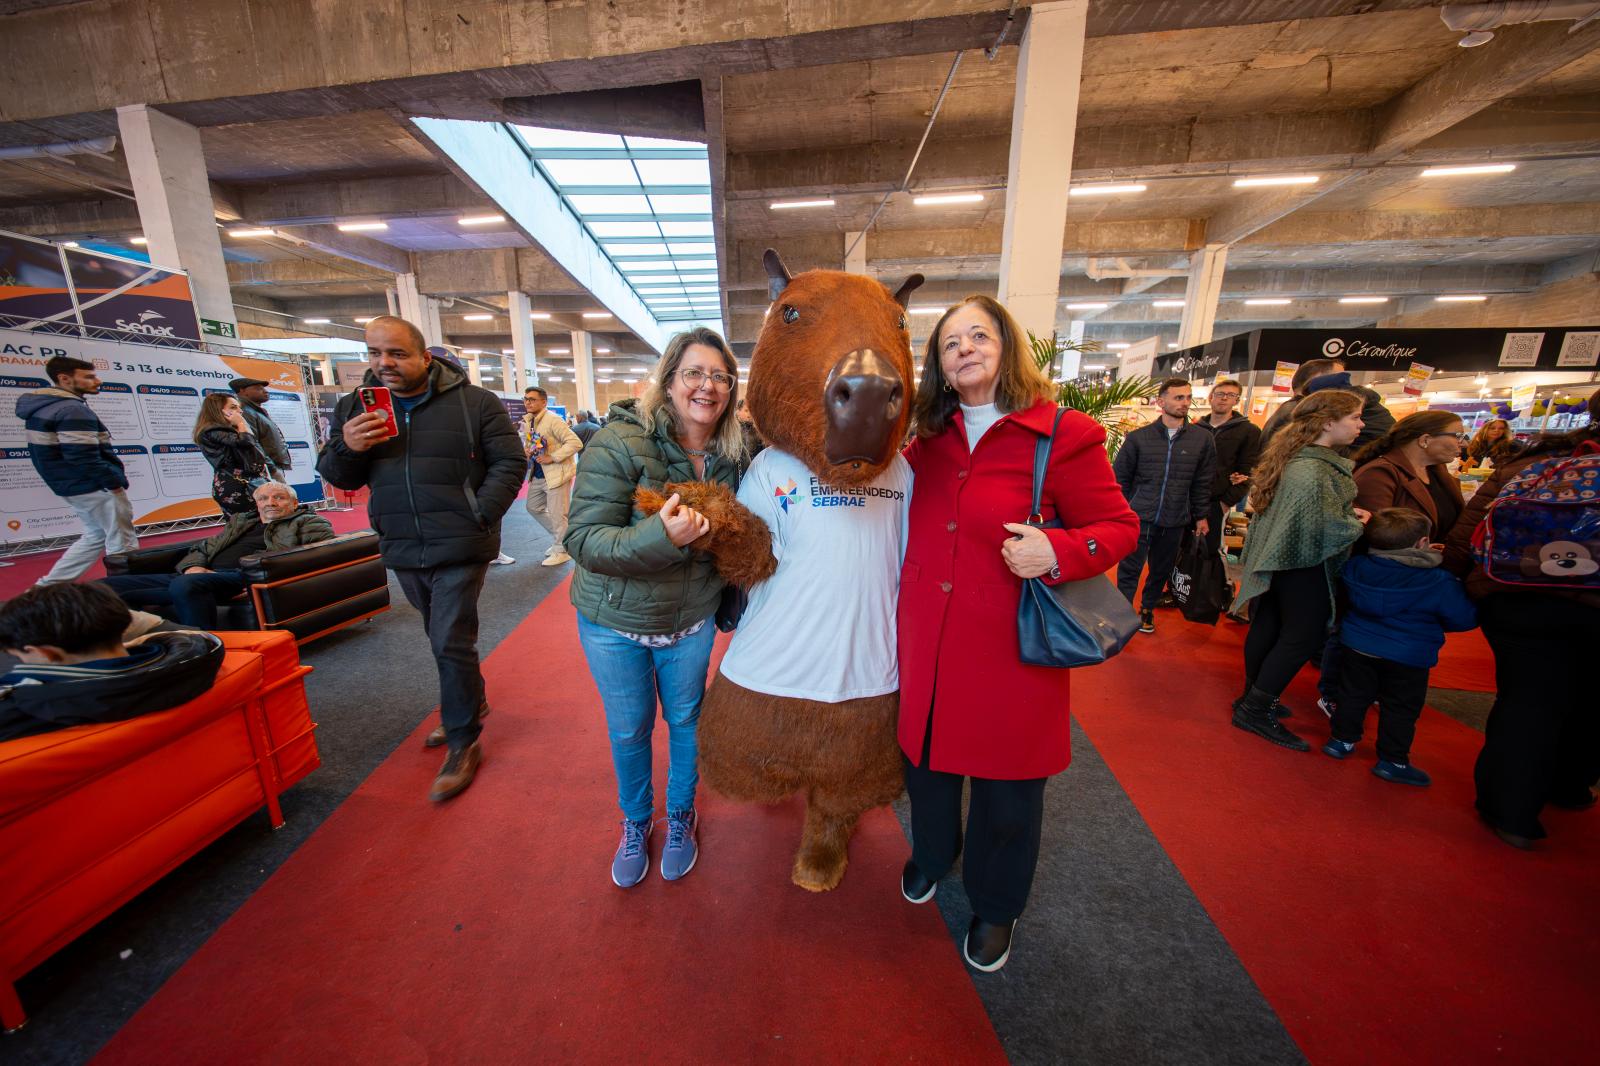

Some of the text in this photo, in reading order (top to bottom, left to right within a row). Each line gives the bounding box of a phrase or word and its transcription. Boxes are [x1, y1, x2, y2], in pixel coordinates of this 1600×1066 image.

[115, 318, 175, 337] Senac
[0, 343, 34, 356] AC
[1346, 340, 1417, 367] Céramique
[113, 361, 122, 371] 3
[138, 363, 152, 373] 13
[156, 365, 173, 375] de
[176, 368, 234, 380] setembro
[811, 486, 905, 502] EMPREENDEDOR
[812, 496, 866, 508] SEBRAE
